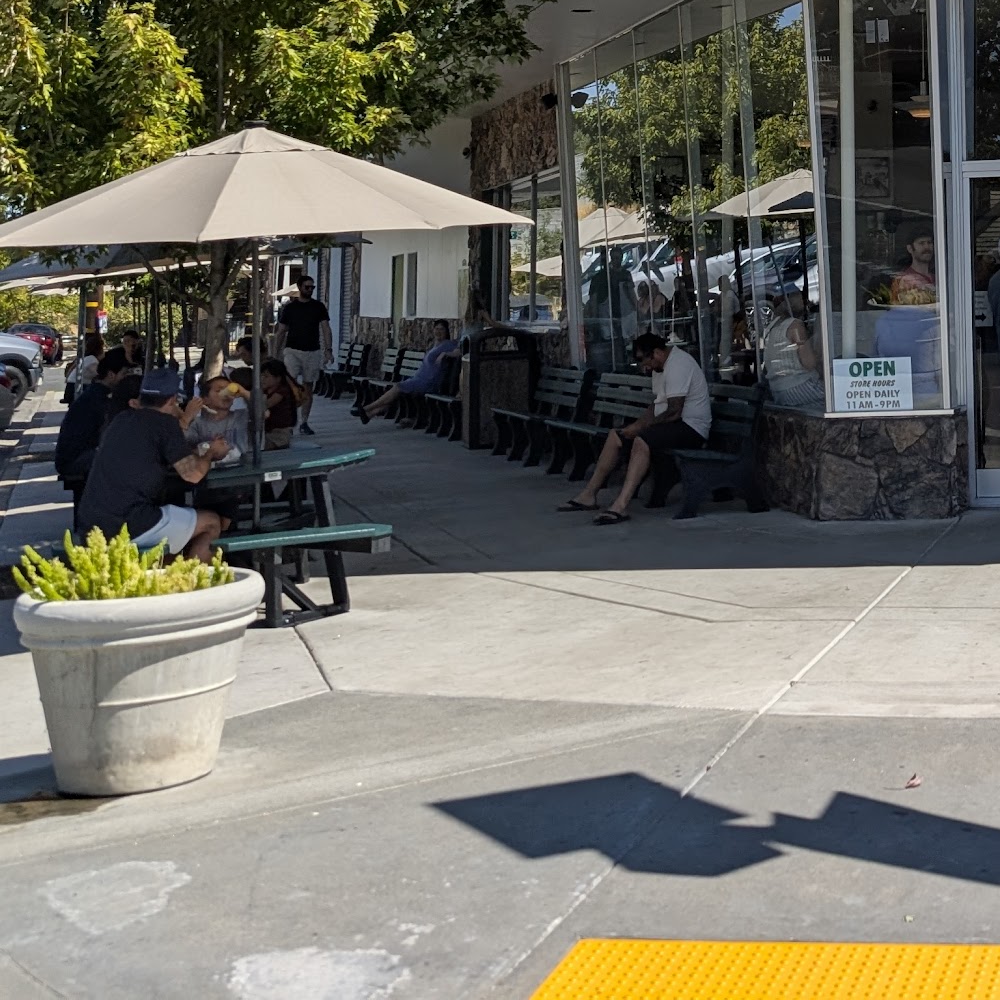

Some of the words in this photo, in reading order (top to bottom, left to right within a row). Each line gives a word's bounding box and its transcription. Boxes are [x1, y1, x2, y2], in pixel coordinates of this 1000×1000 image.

[849, 361, 896, 377] OPEN
[850, 380, 871, 388] STORE
[872, 379, 896, 387] HOURS
[846, 390, 871, 399] OPEN
[874, 389, 900, 398] DAILY
